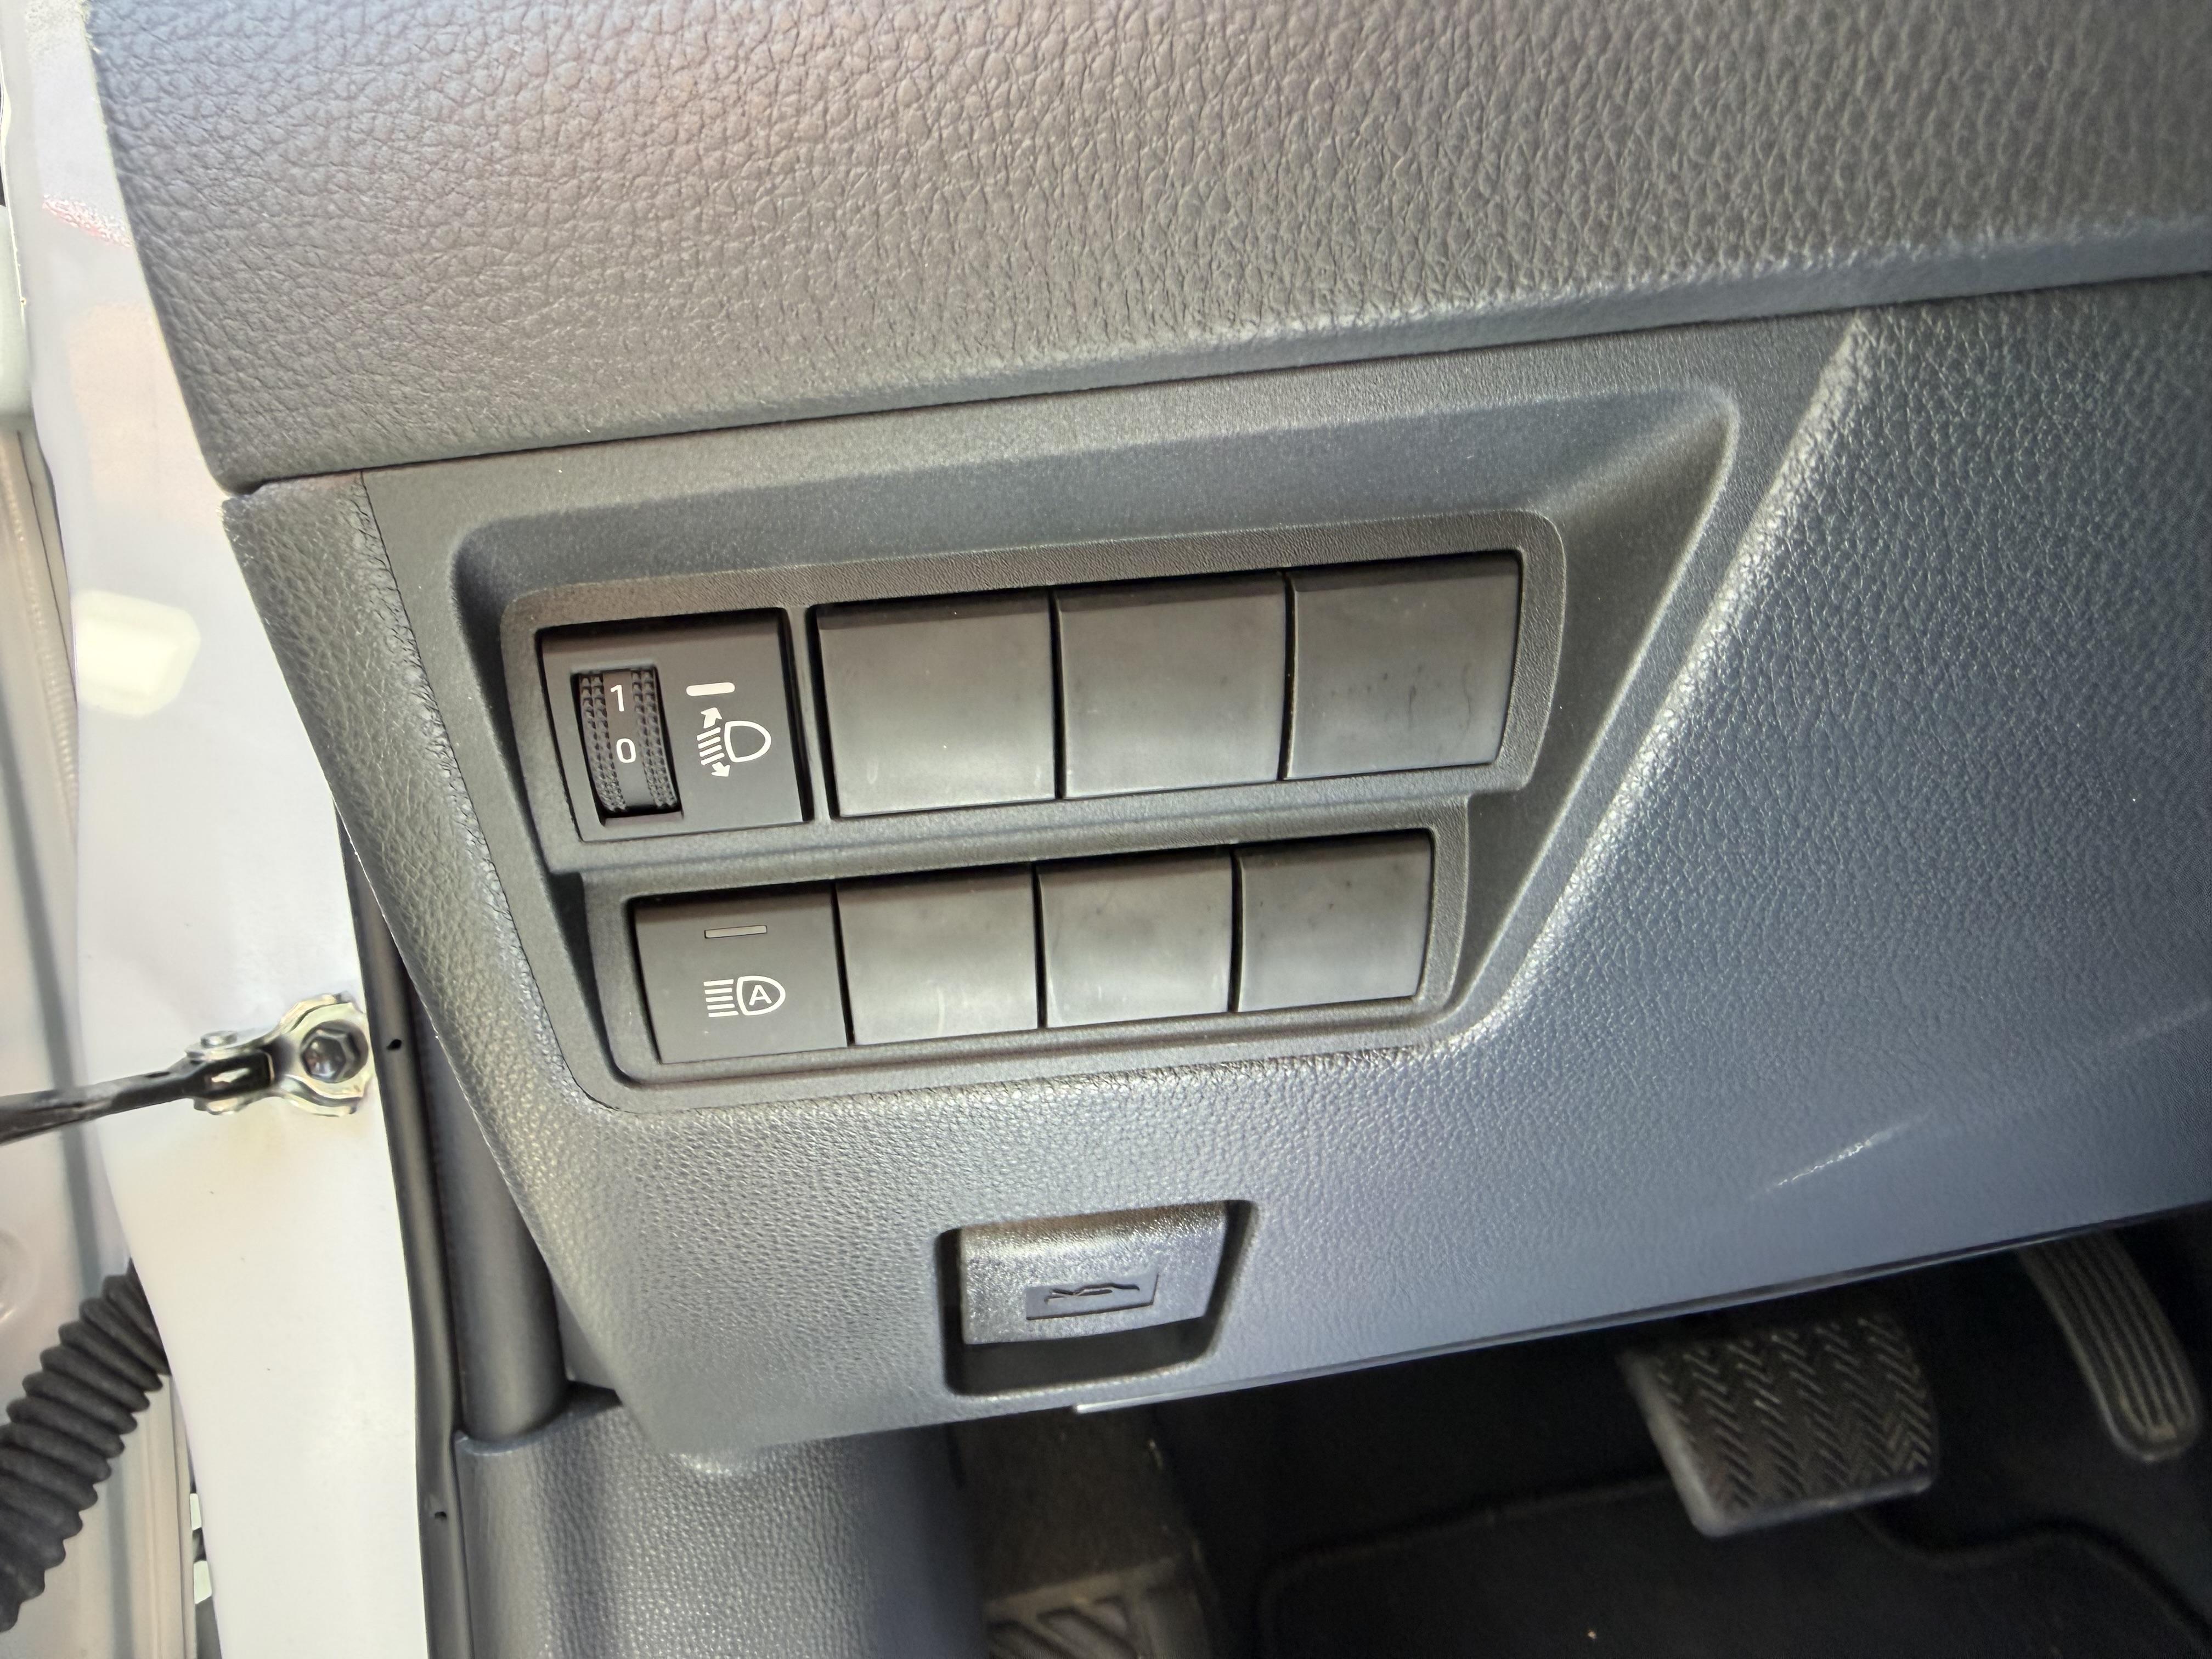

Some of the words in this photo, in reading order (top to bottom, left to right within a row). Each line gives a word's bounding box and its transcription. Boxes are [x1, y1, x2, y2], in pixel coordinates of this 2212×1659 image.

[610, 684, 625, 712] 1
[616, 738, 636, 763] 0
[749, 985, 772, 1006] A
